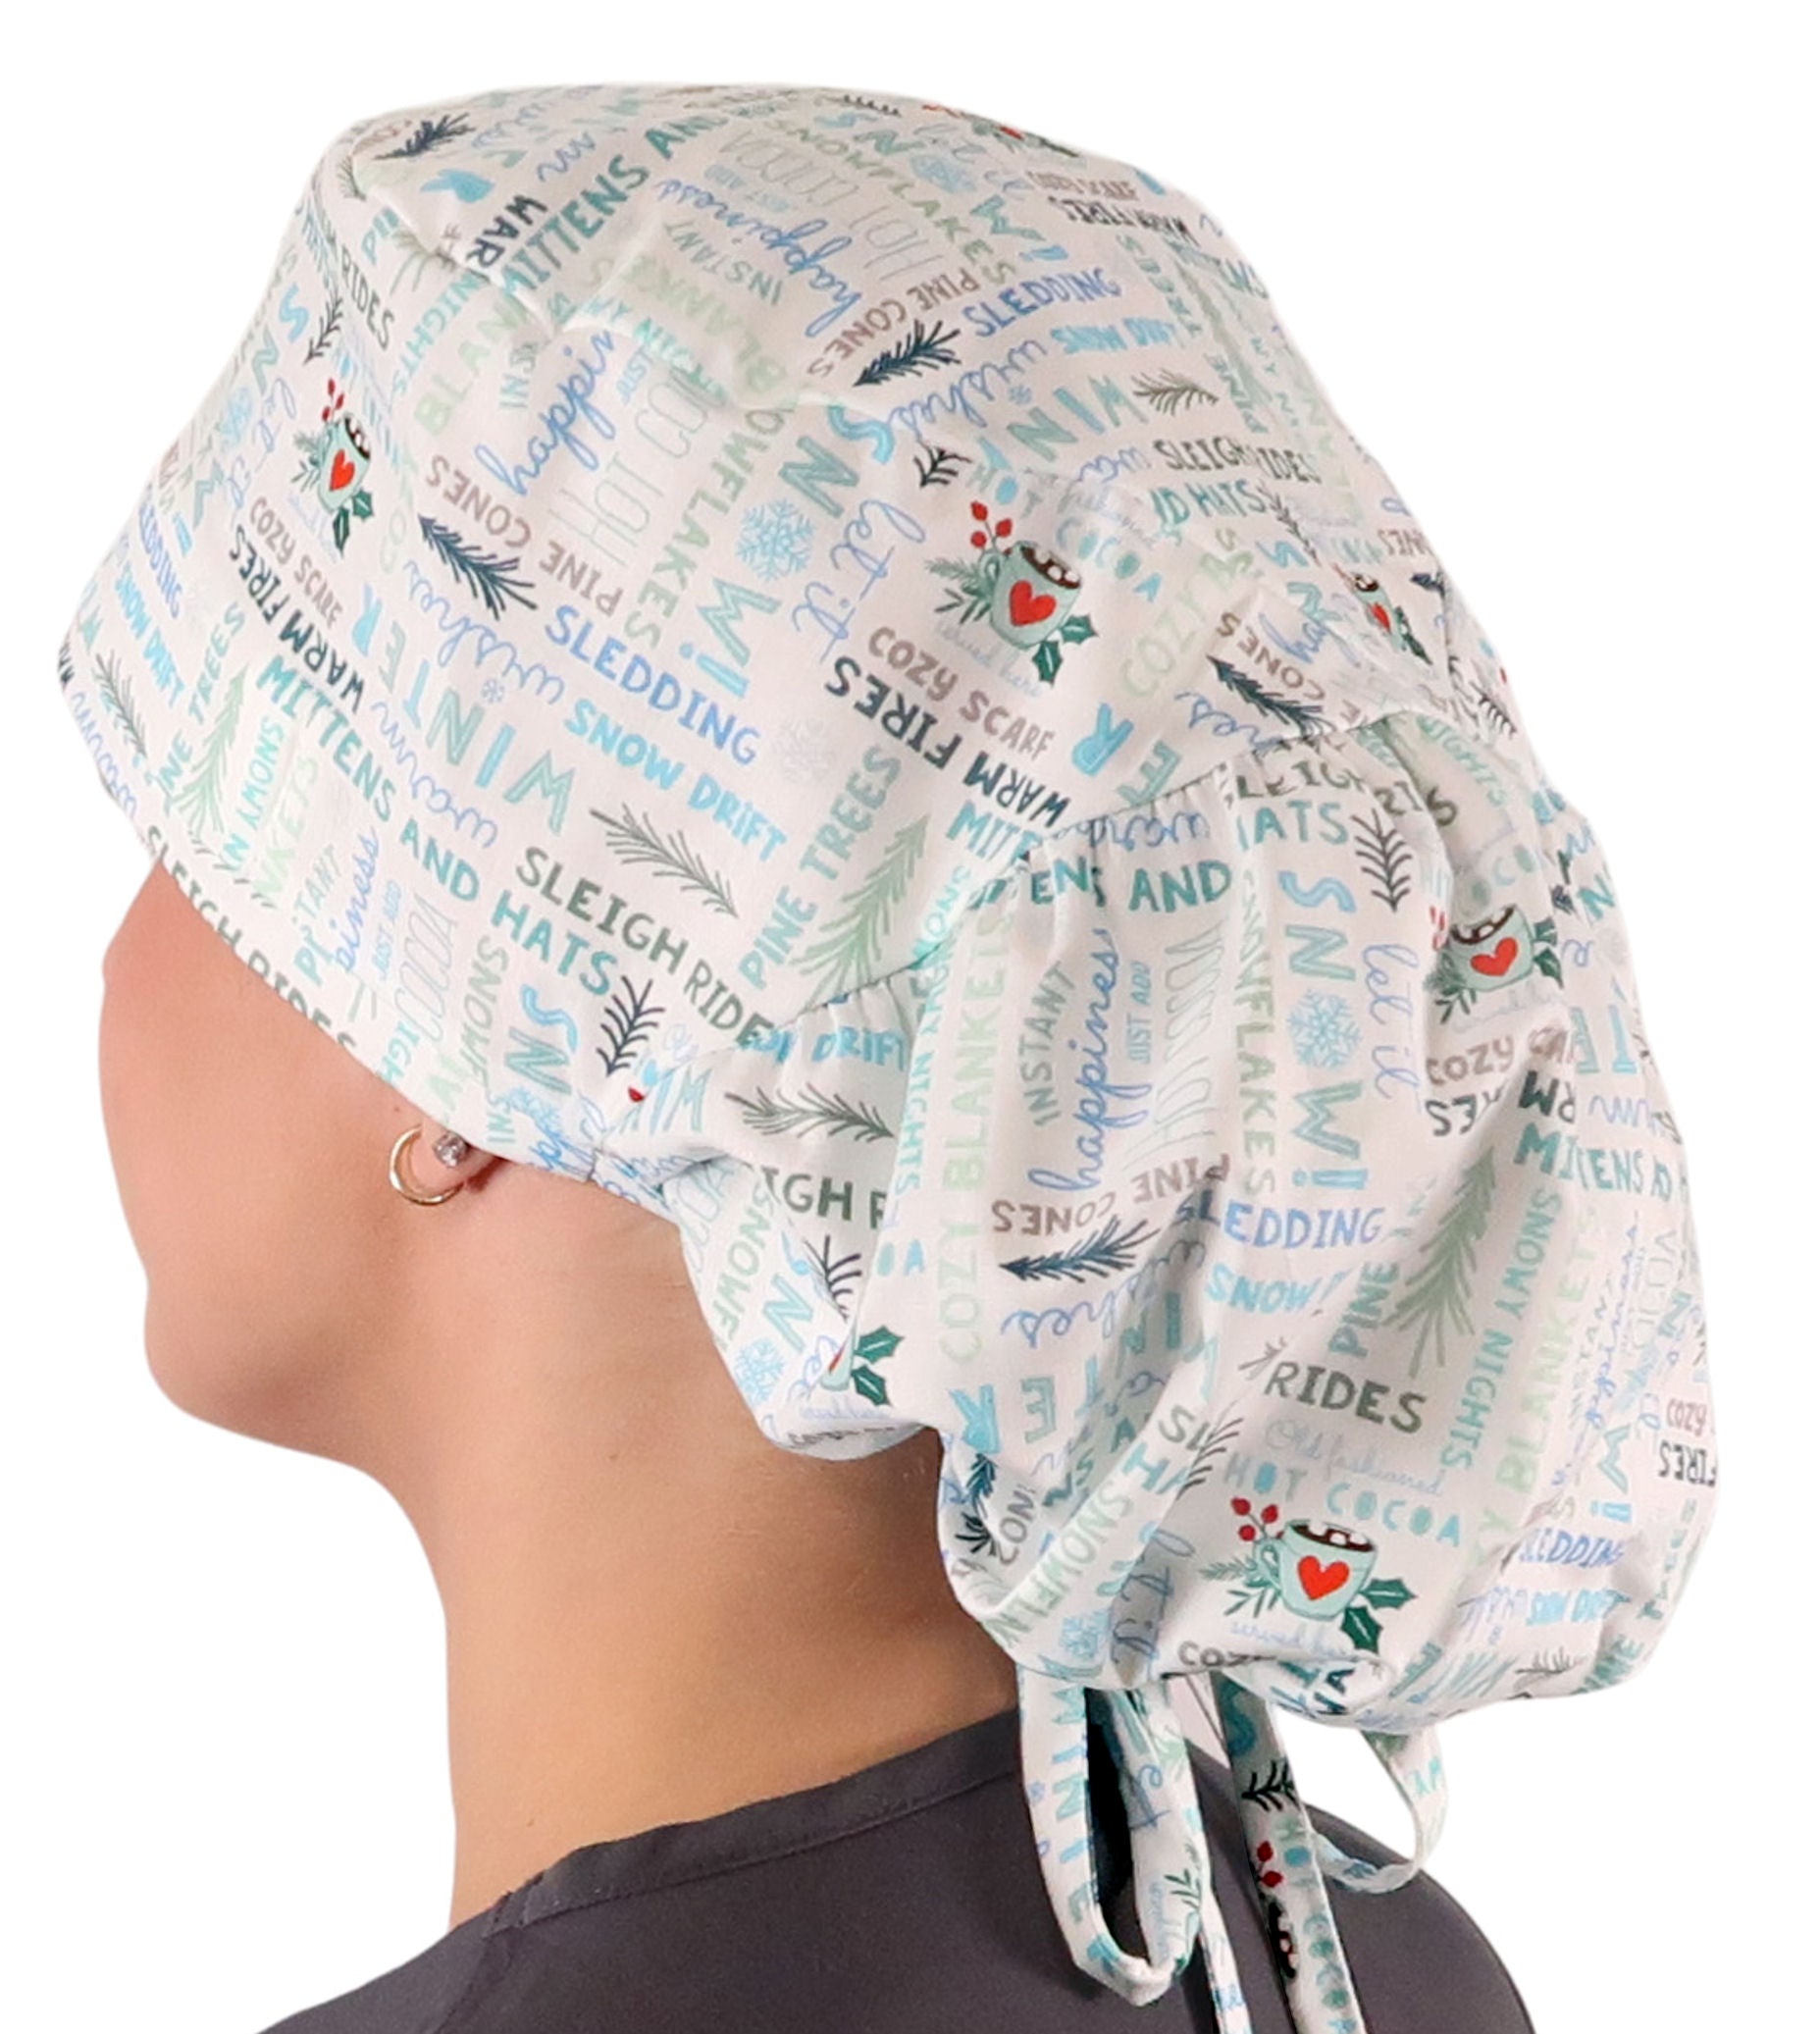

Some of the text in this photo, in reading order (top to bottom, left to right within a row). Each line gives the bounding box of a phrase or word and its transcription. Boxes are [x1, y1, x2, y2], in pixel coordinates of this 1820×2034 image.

[466, 193, 548, 268] WAR
[339, 244, 396, 351] RIDES
[806, 266, 982, 379] PINE CONES
[962, 267, 1123, 339] SLEDDING
[473, 330, 618, 495] happin
[249, 496, 343, 629] COZY SCARF
[424, 453, 625, 617] PINE CONES
[229, 524, 366, 714] WARM FIRES
[545, 604, 762, 766] SLEDDING
[823, 654, 964, 771] FIRES
[867, 625, 960, 703] COZY
[958, 689, 1058, 763] SCARF
[255, 653, 619, 996] MITTENS AND HATS
[563, 698, 788, 863] SNOW DRIFT
[962, 749, 1072, 829] WARM
[514, 845, 691, 976] SLEIGH
[738, 742, 904, 991] PINE TREES
[1128, 860, 1232, 913] AND
[1017, 961, 1077, 1127] INSTANT
[1027, 927, 1153, 1192] happiness
[1126, 958, 1153, 1067] JUST ADD
[1425, 1033, 1517, 1087] COZY
[991, 1191, 1118, 1237] CONES
[1493, 1185, 1564, 1323] SNOWY
[1205, 1261, 1320, 1316] SNOW
[1327, 1260, 1400, 1361] PINE
[1264, 1357, 1428, 1435] RIDES
[1438, 1328, 1514, 1471] NIGHTS
[1223, 1452, 1309, 1501] HOT
[1326, 1482, 1462, 1549] COCOA
